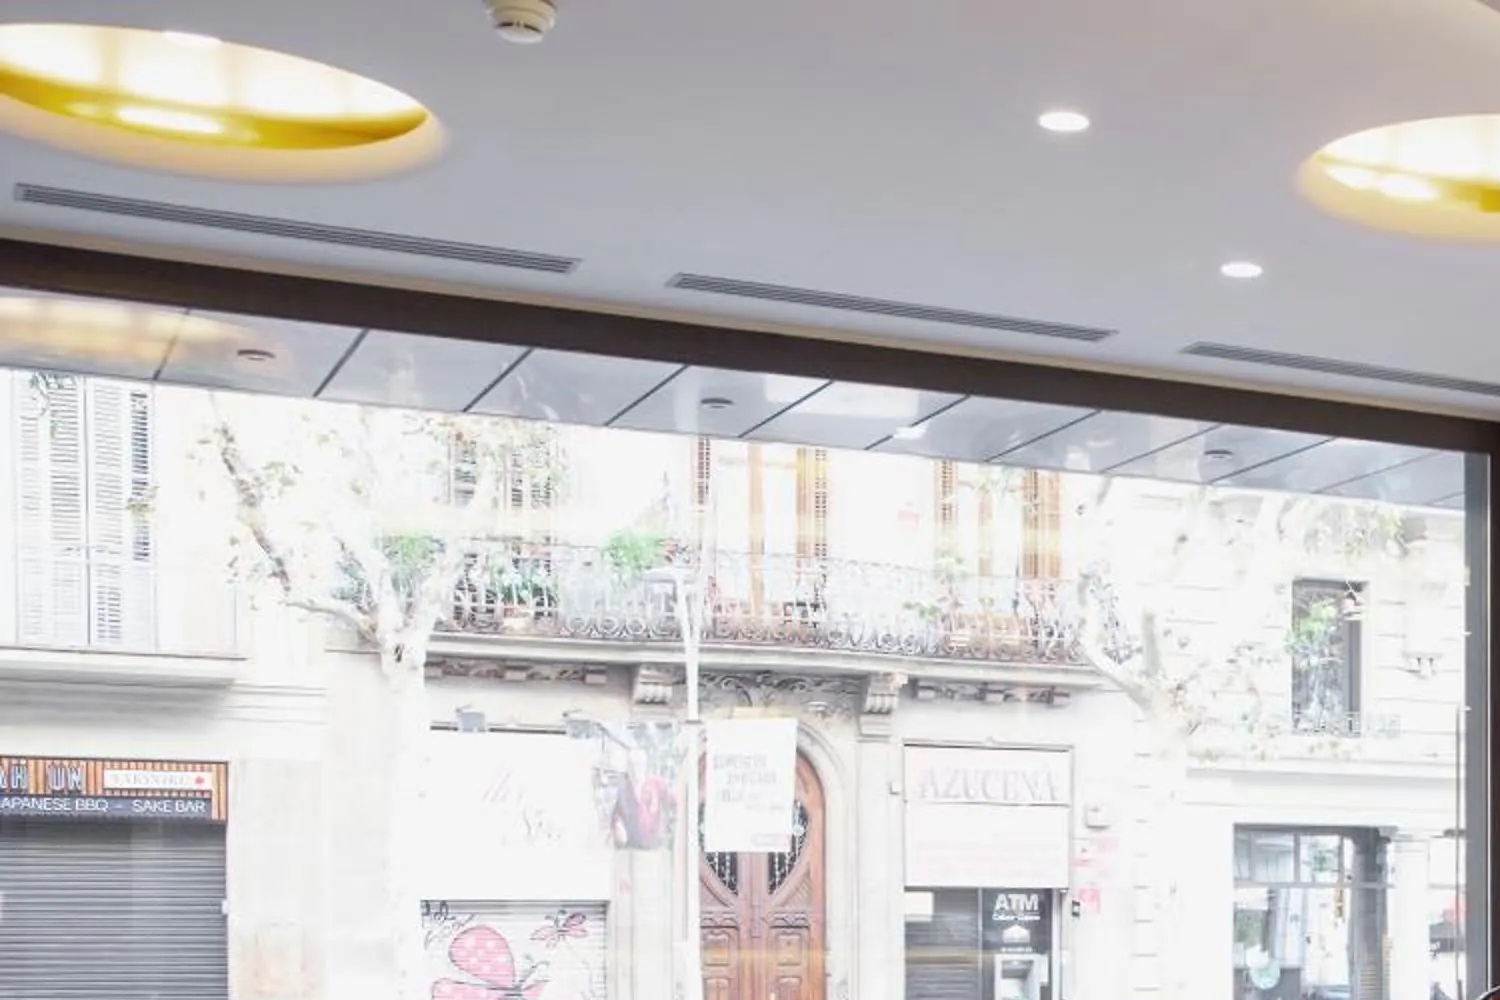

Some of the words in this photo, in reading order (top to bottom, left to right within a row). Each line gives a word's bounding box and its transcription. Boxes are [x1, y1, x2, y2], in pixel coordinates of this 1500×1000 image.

[918, 766, 1060, 801] AZUCENA
[75, 798, 109, 812] BBQ
[132, 799, 172, 813] SAKE
[174, 799, 207, 813] BAR
[994, 893, 1039, 911] ATM
